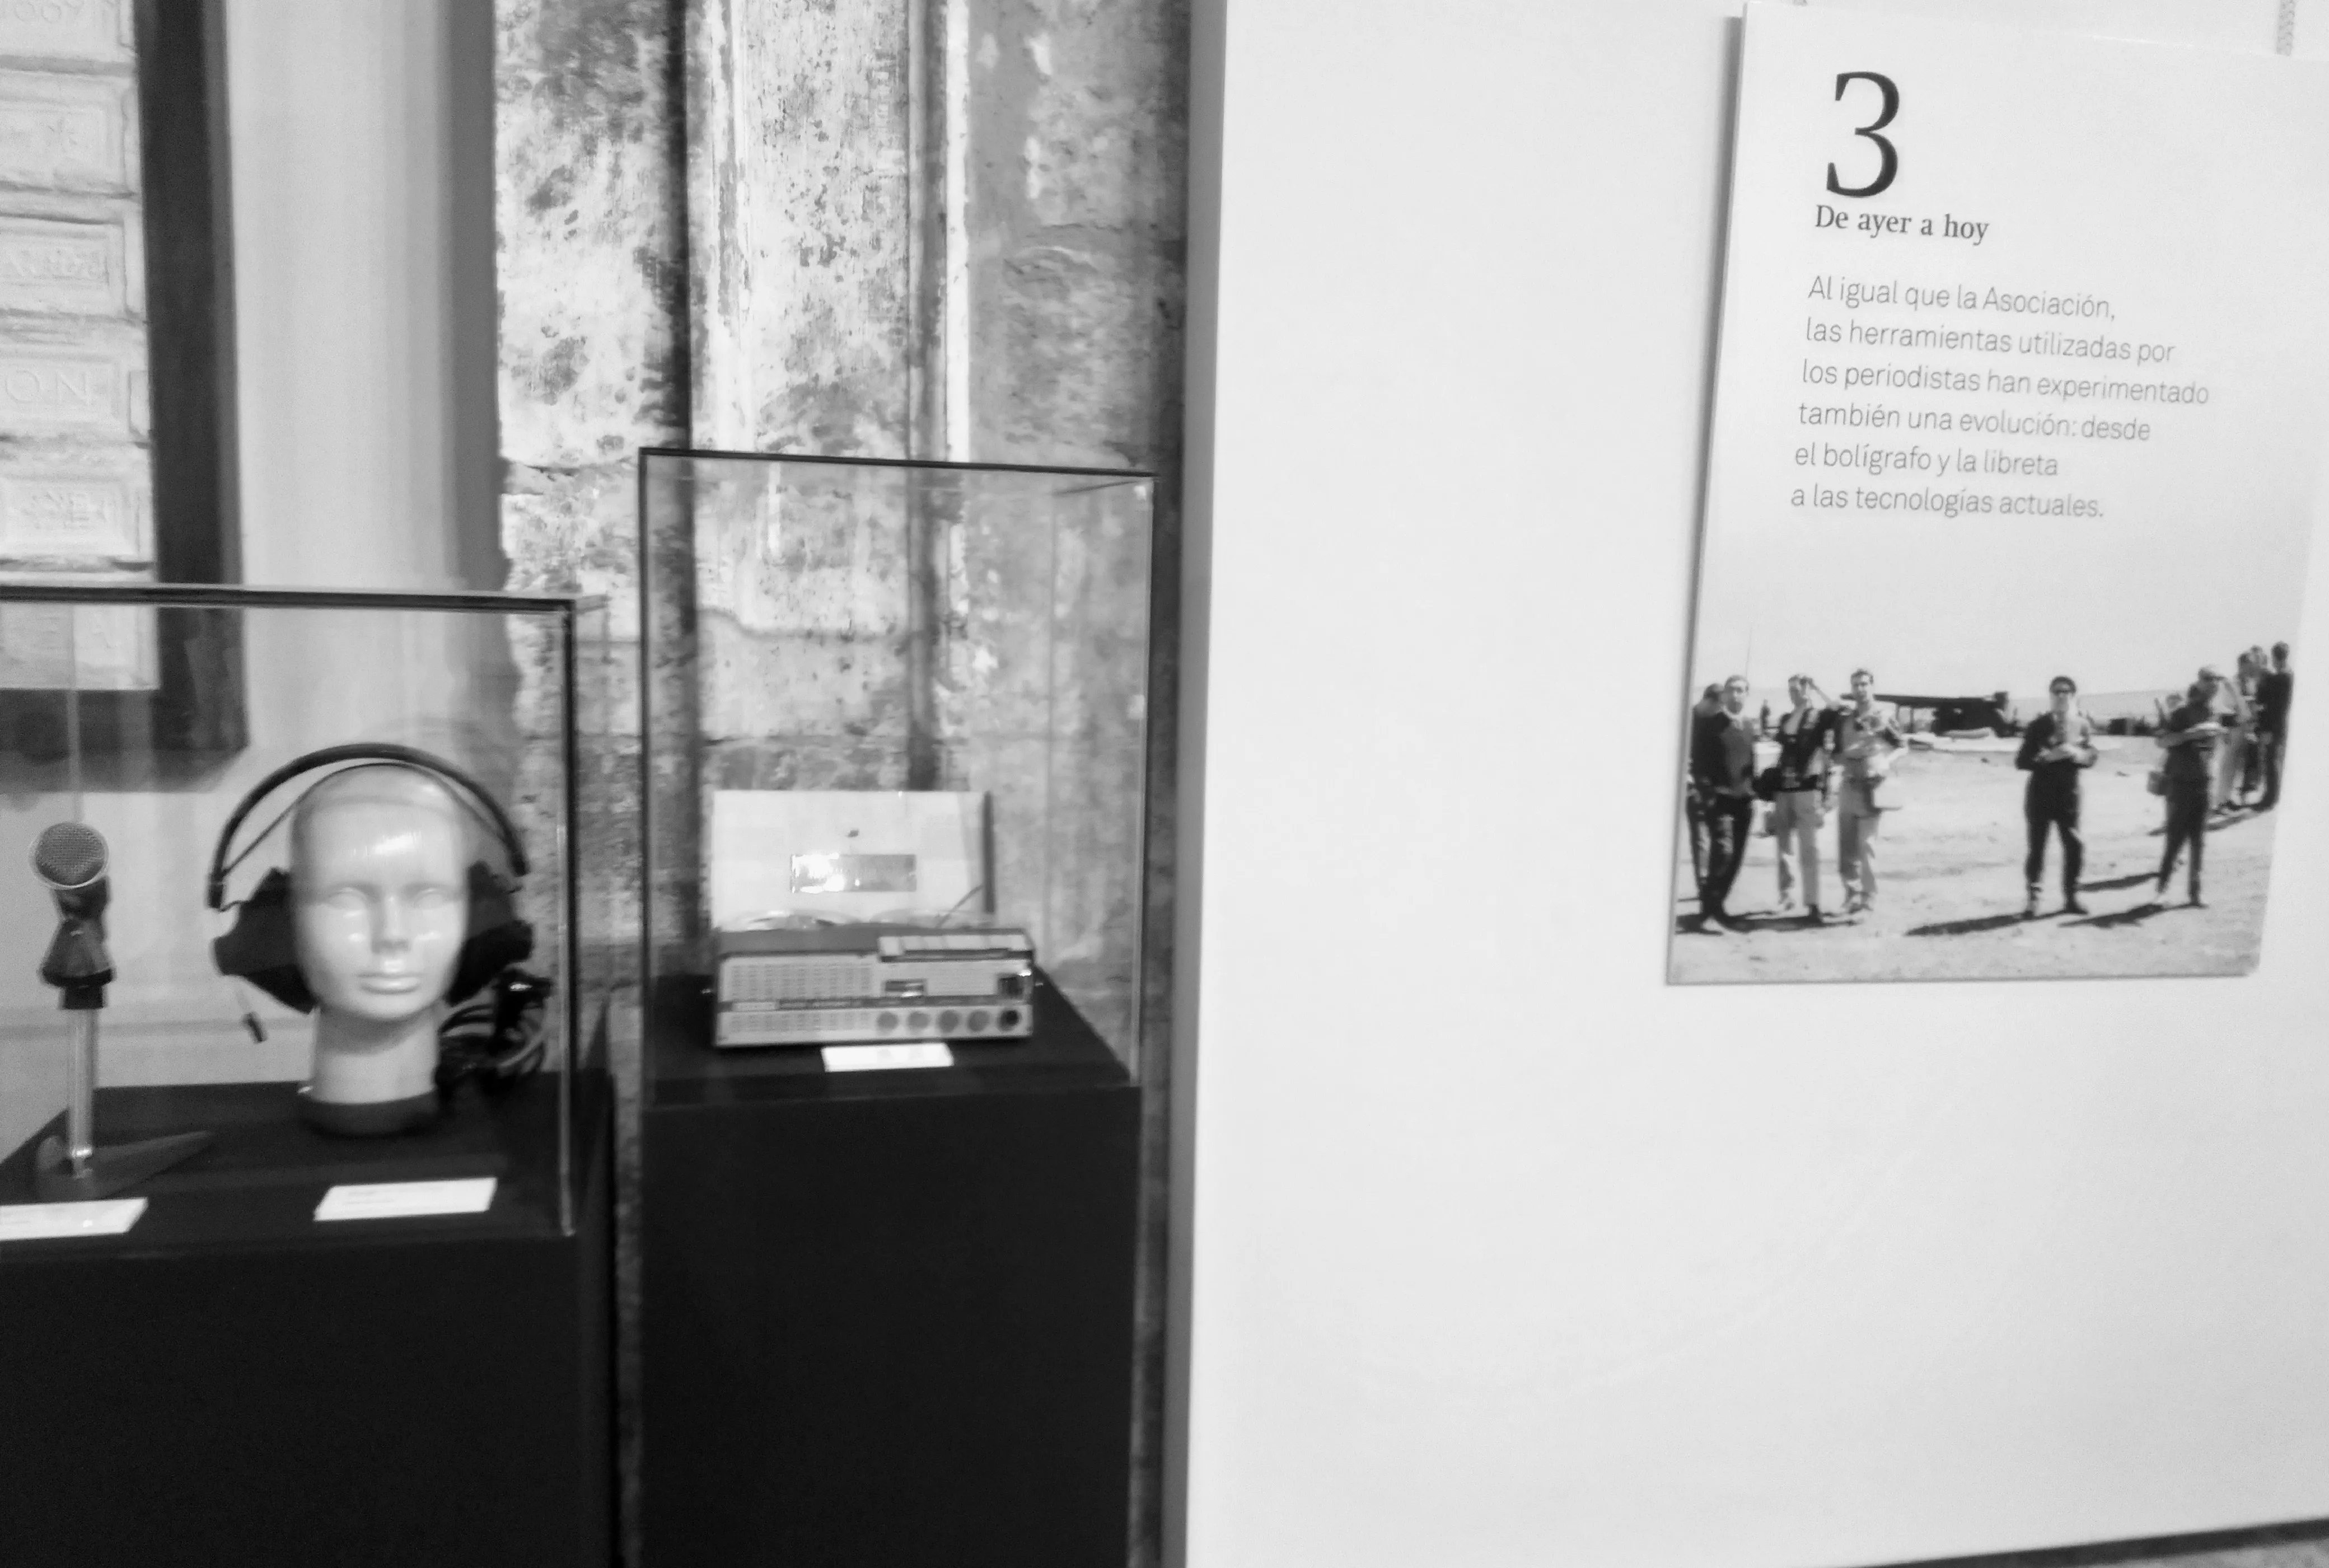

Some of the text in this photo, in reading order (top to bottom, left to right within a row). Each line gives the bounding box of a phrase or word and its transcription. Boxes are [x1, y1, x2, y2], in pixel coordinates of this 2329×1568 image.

[1826, 71, 1900, 199] 3
[1815, 204, 1989, 246] De ayer a hoy
[1808, 275, 2115, 322] Al igual que la Asociación,
[1806, 316, 2176, 367] las herramientas utilizadas por
[1802, 358, 2209, 405] los periodistas han experimentado
[1799, 402, 2150, 442] también una evolución: desde
[1794, 442, 2058, 478] el bolígrafo y la libreta
[1790, 483, 2104, 519] a las tecnologías actuales.
